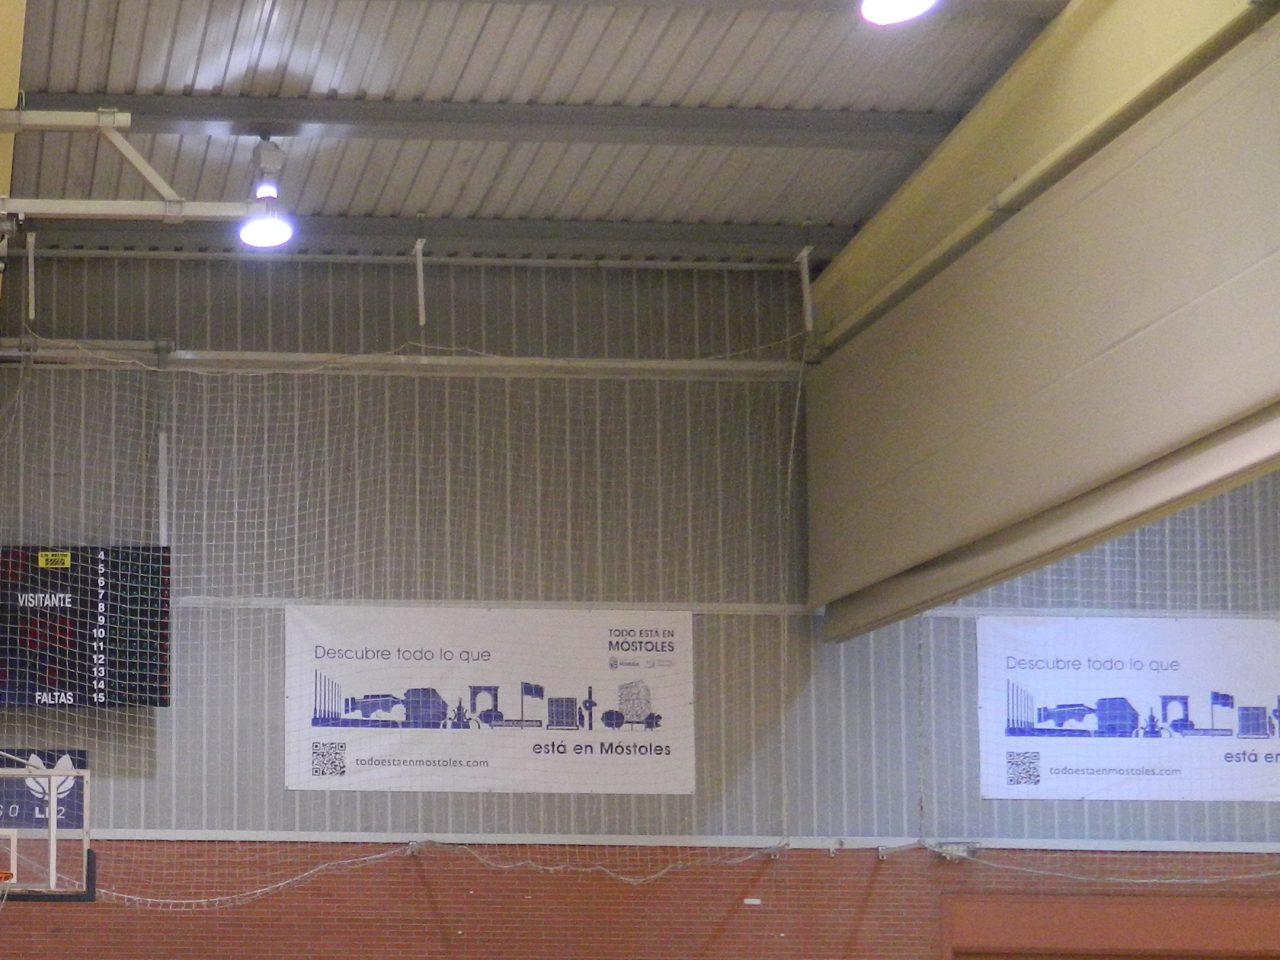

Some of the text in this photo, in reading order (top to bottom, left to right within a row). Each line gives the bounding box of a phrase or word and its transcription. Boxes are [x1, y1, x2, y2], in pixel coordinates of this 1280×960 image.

[98, 551, 105, 560] 4
[98, 564, 105, 573] 5
[98, 577, 105, 586] 6
[98, 590, 105, 599] 7
[18, 594, 72, 607] VISITANTE
[98, 603, 105, 612] 8
[98, 616, 105, 625] 9
[92, 629, 105, 638] 10
[608, 629, 636, 637] TODO
[92, 642, 105, 650] 11
[608, 638, 675, 652] MÓSTOLES
[92, 654, 105, 664] 12
[315, 645, 491, 664] Descubre todo lo que
[1006, 656, 1181, 673] Descubre todo lo que
[92, 667, 105, 676] 13
[92, 680, 105, 689] 14
[36, 692, 74, 704] FALTAS
[92, 693, 105, 702] 15
[533, 741, 671, 756] está en Móstoles
[1224, 749, 1258, 763] está
[355, 756, 489, 768] todoestaenmostoles.com
[1049, 766, 1181, 776] todoestaenmostoles.com
[9, 804, 19, 817] a
